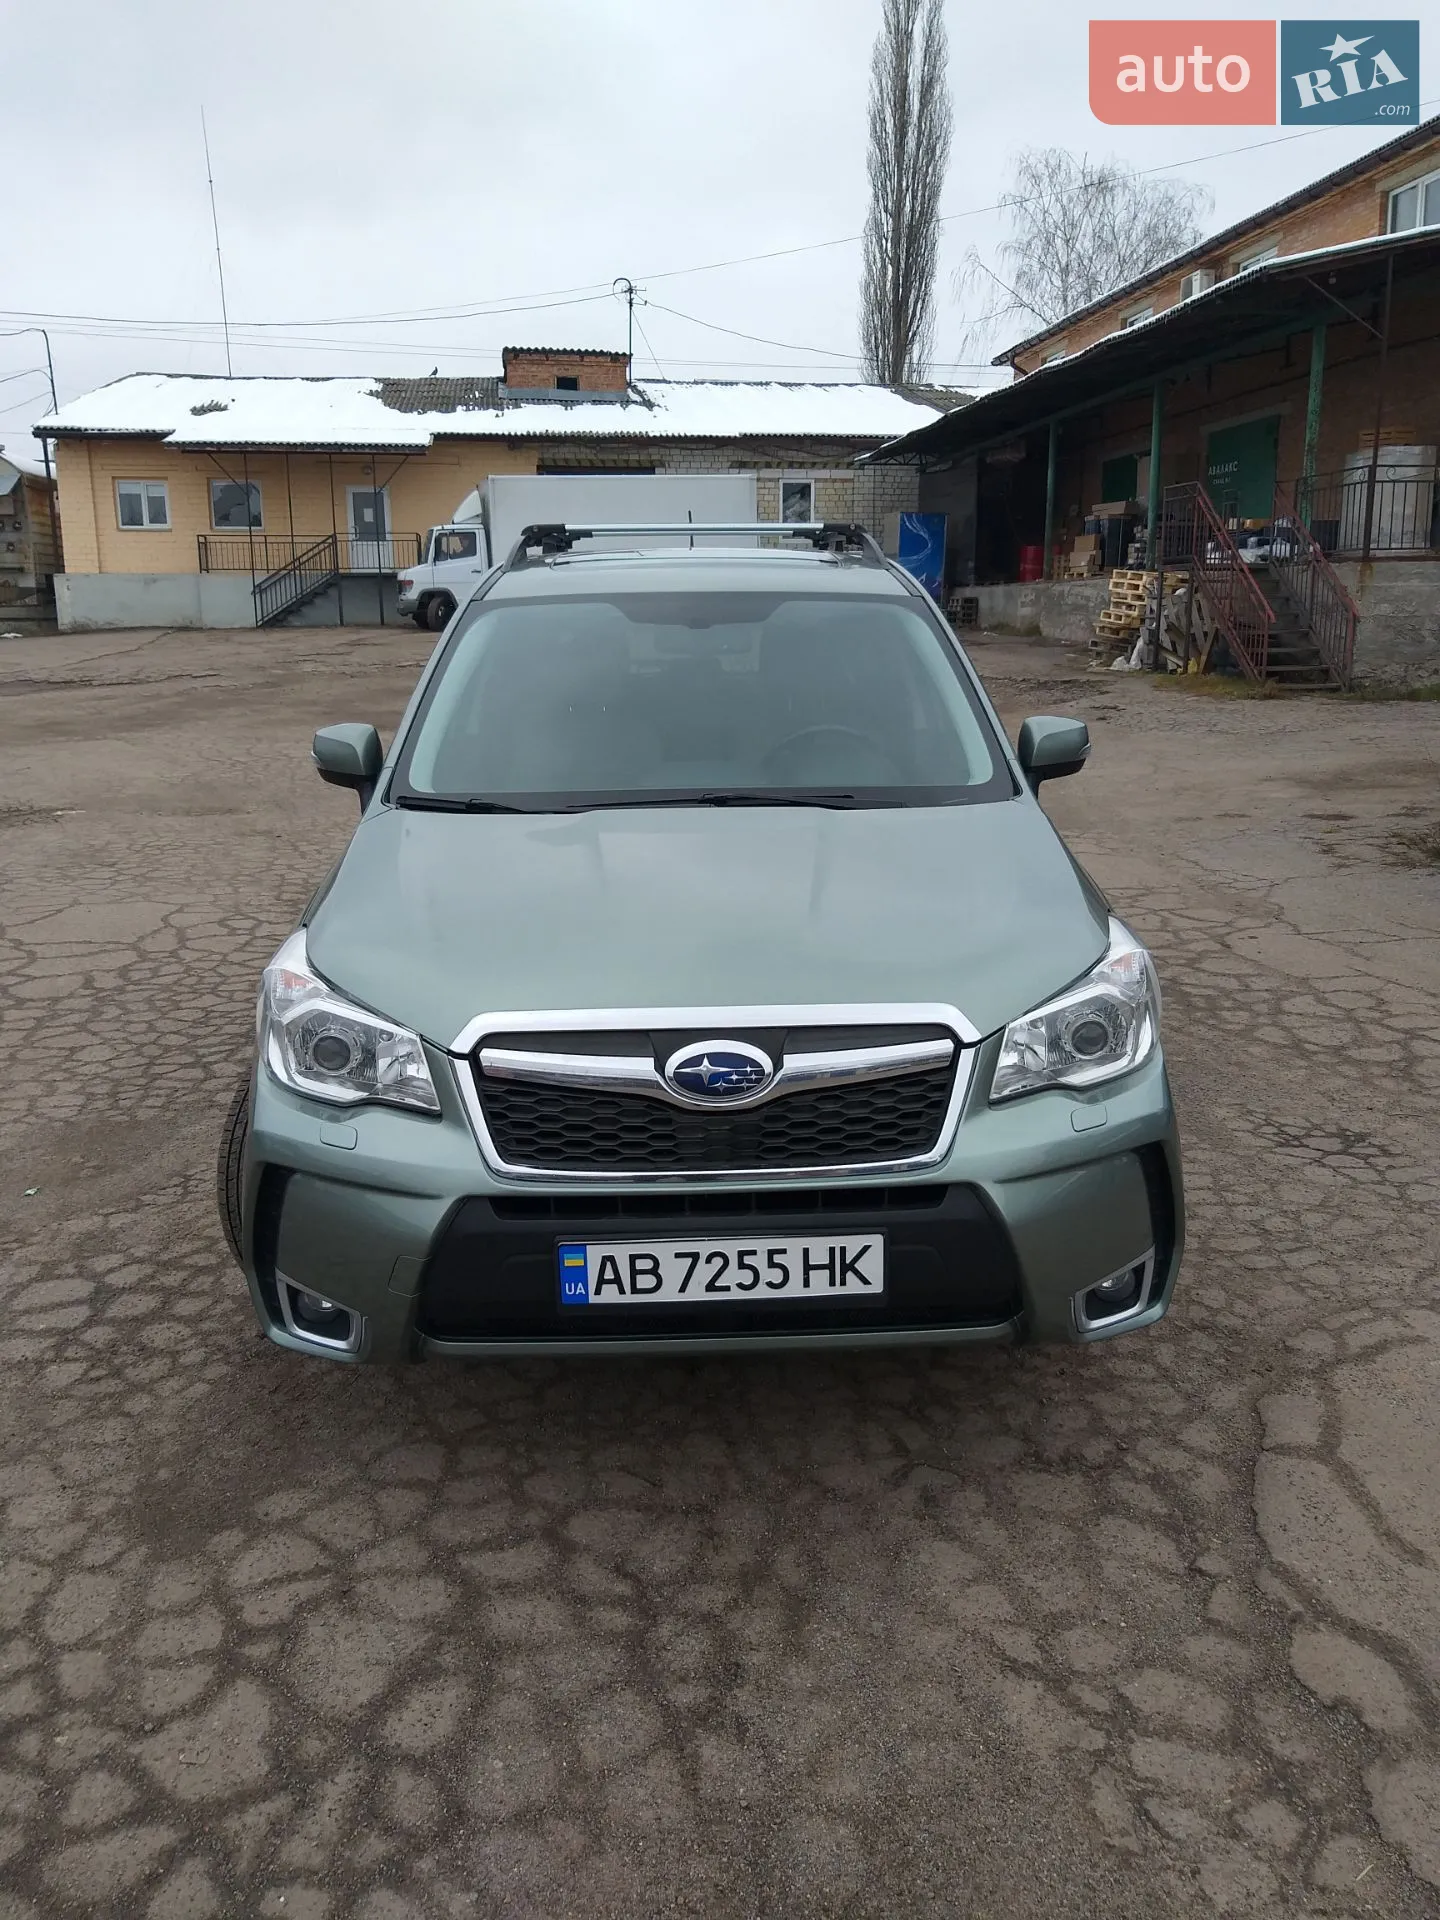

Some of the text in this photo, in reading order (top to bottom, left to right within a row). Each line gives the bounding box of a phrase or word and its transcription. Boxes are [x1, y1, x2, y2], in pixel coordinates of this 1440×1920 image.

[594, 1245, 873, 1296] AB 7255 HK
[565, 1283, 586, 1295] UA
